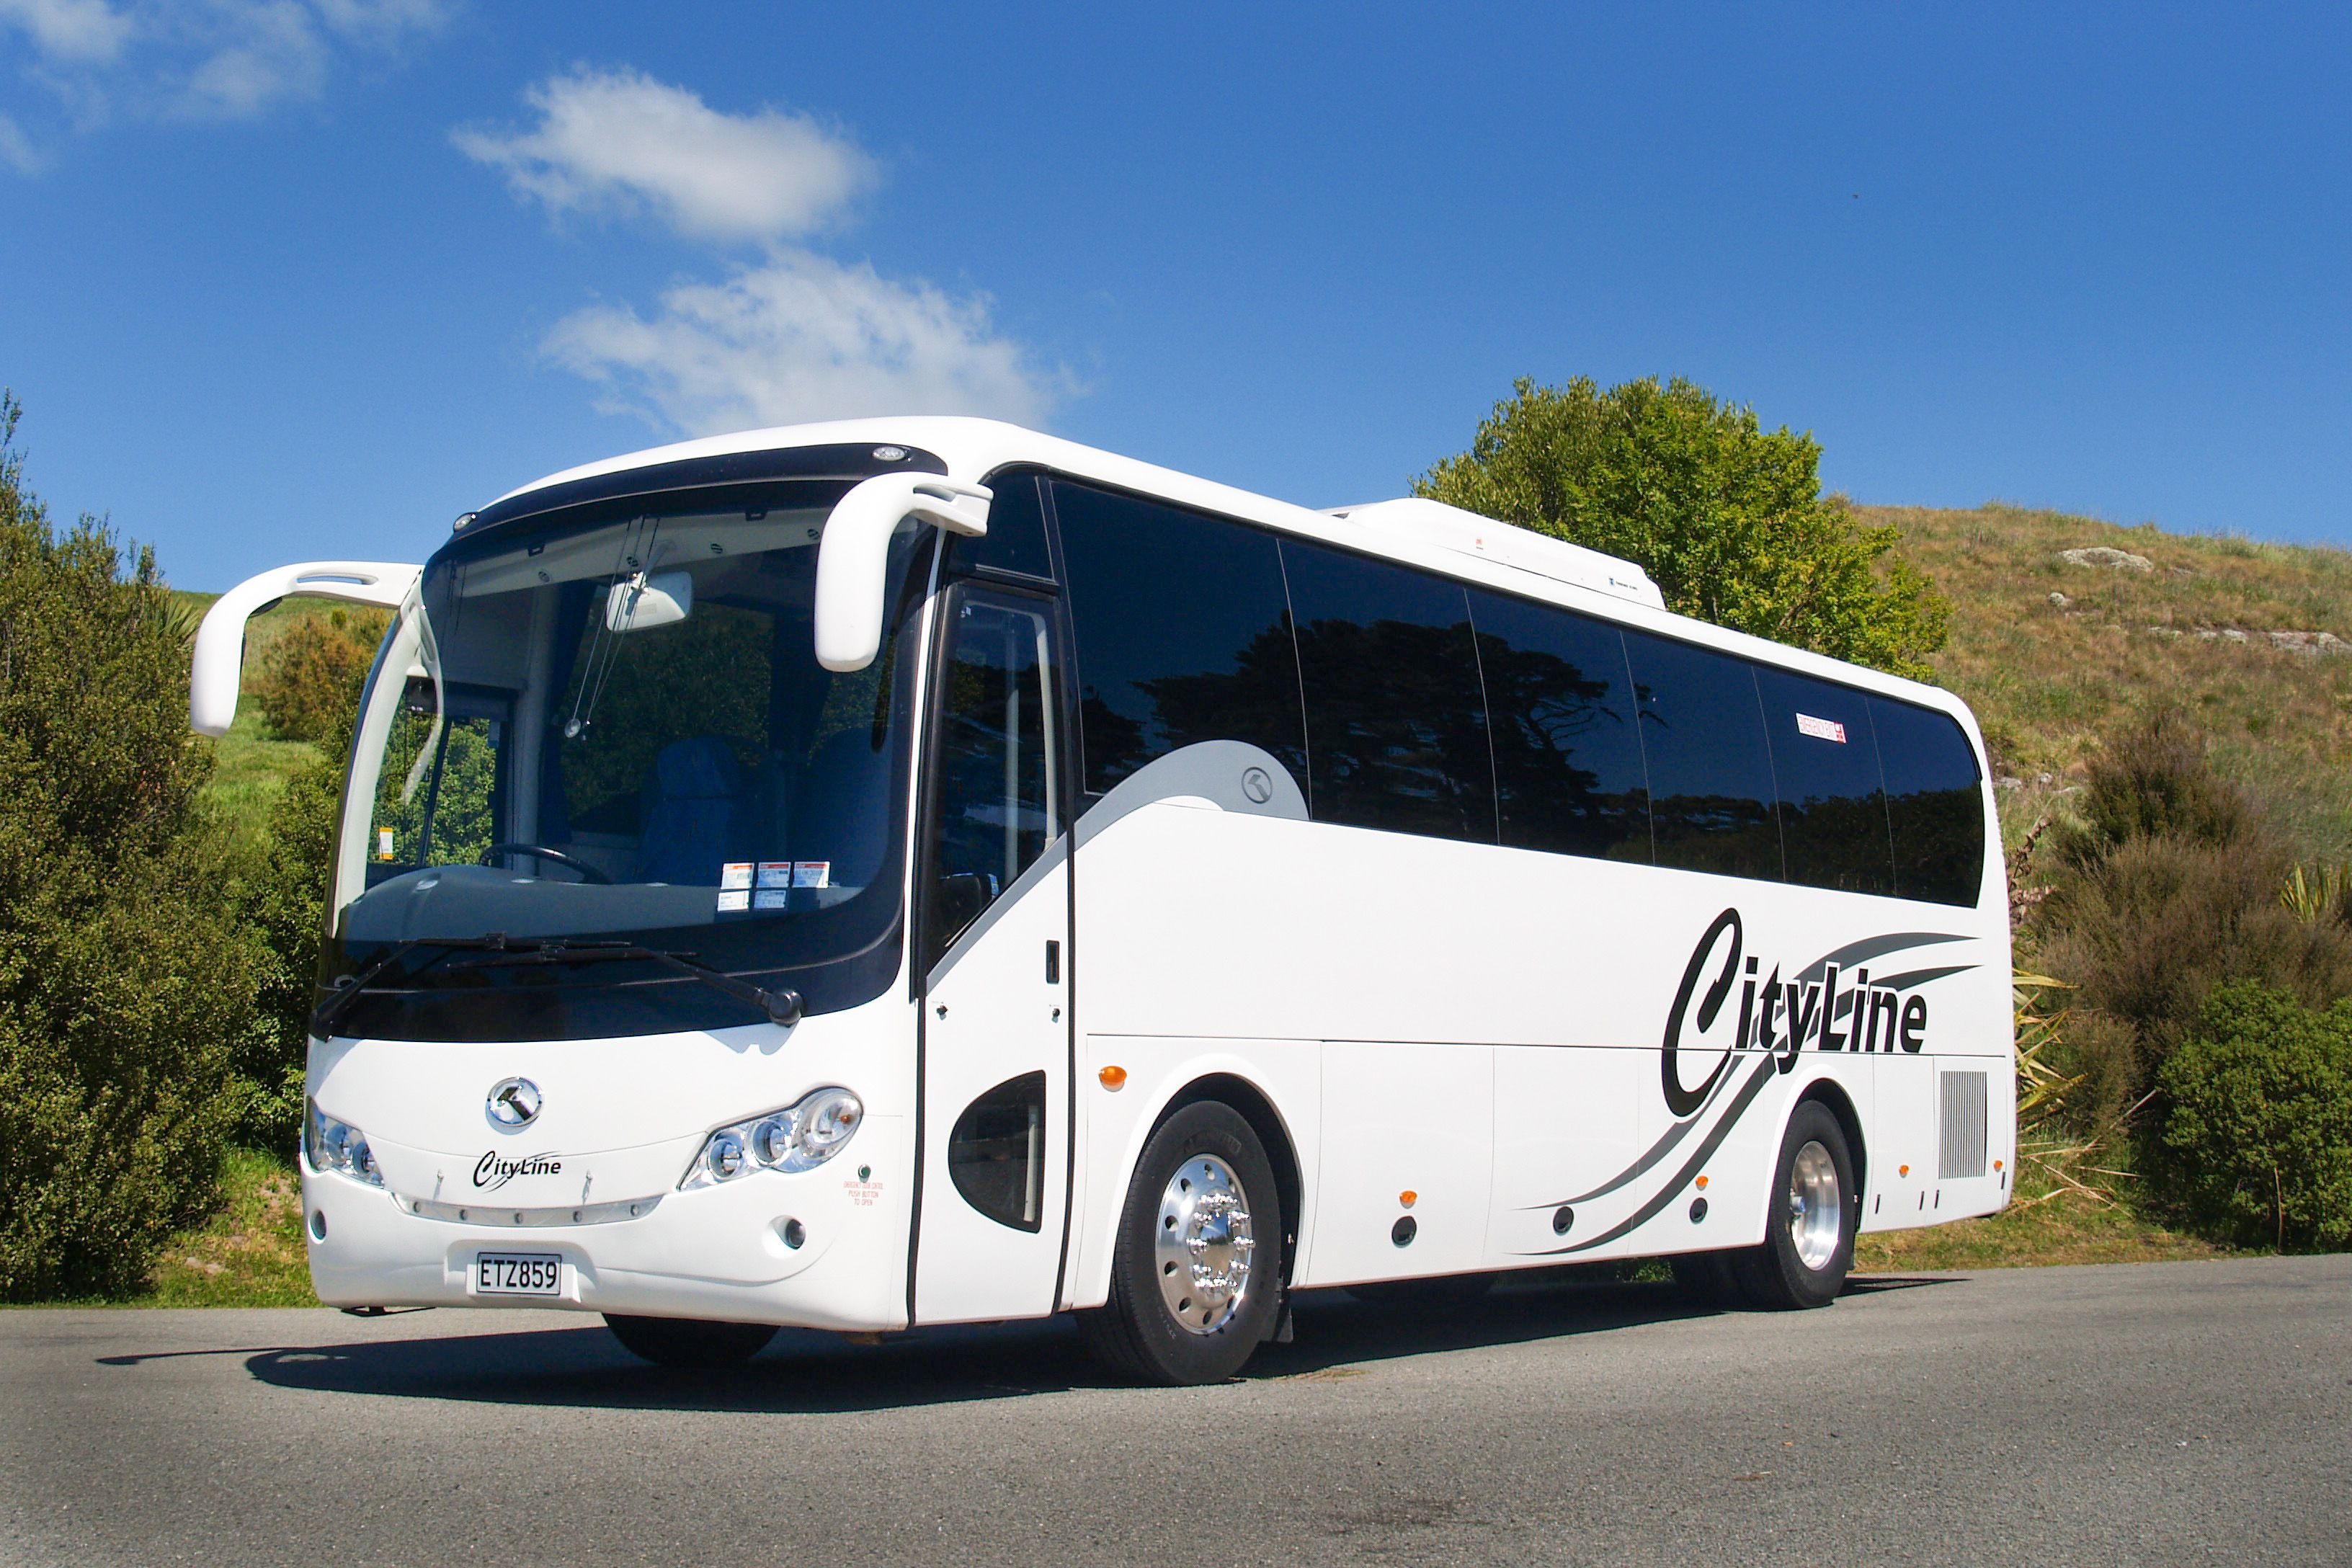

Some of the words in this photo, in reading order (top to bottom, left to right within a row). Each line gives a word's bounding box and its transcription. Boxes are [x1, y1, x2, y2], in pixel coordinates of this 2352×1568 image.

[1662, 908, 1927, 1118] CityLine
[473, 1150, 561, 1188] CityLine
[480, 1259, 557, 1288] ETZ859
